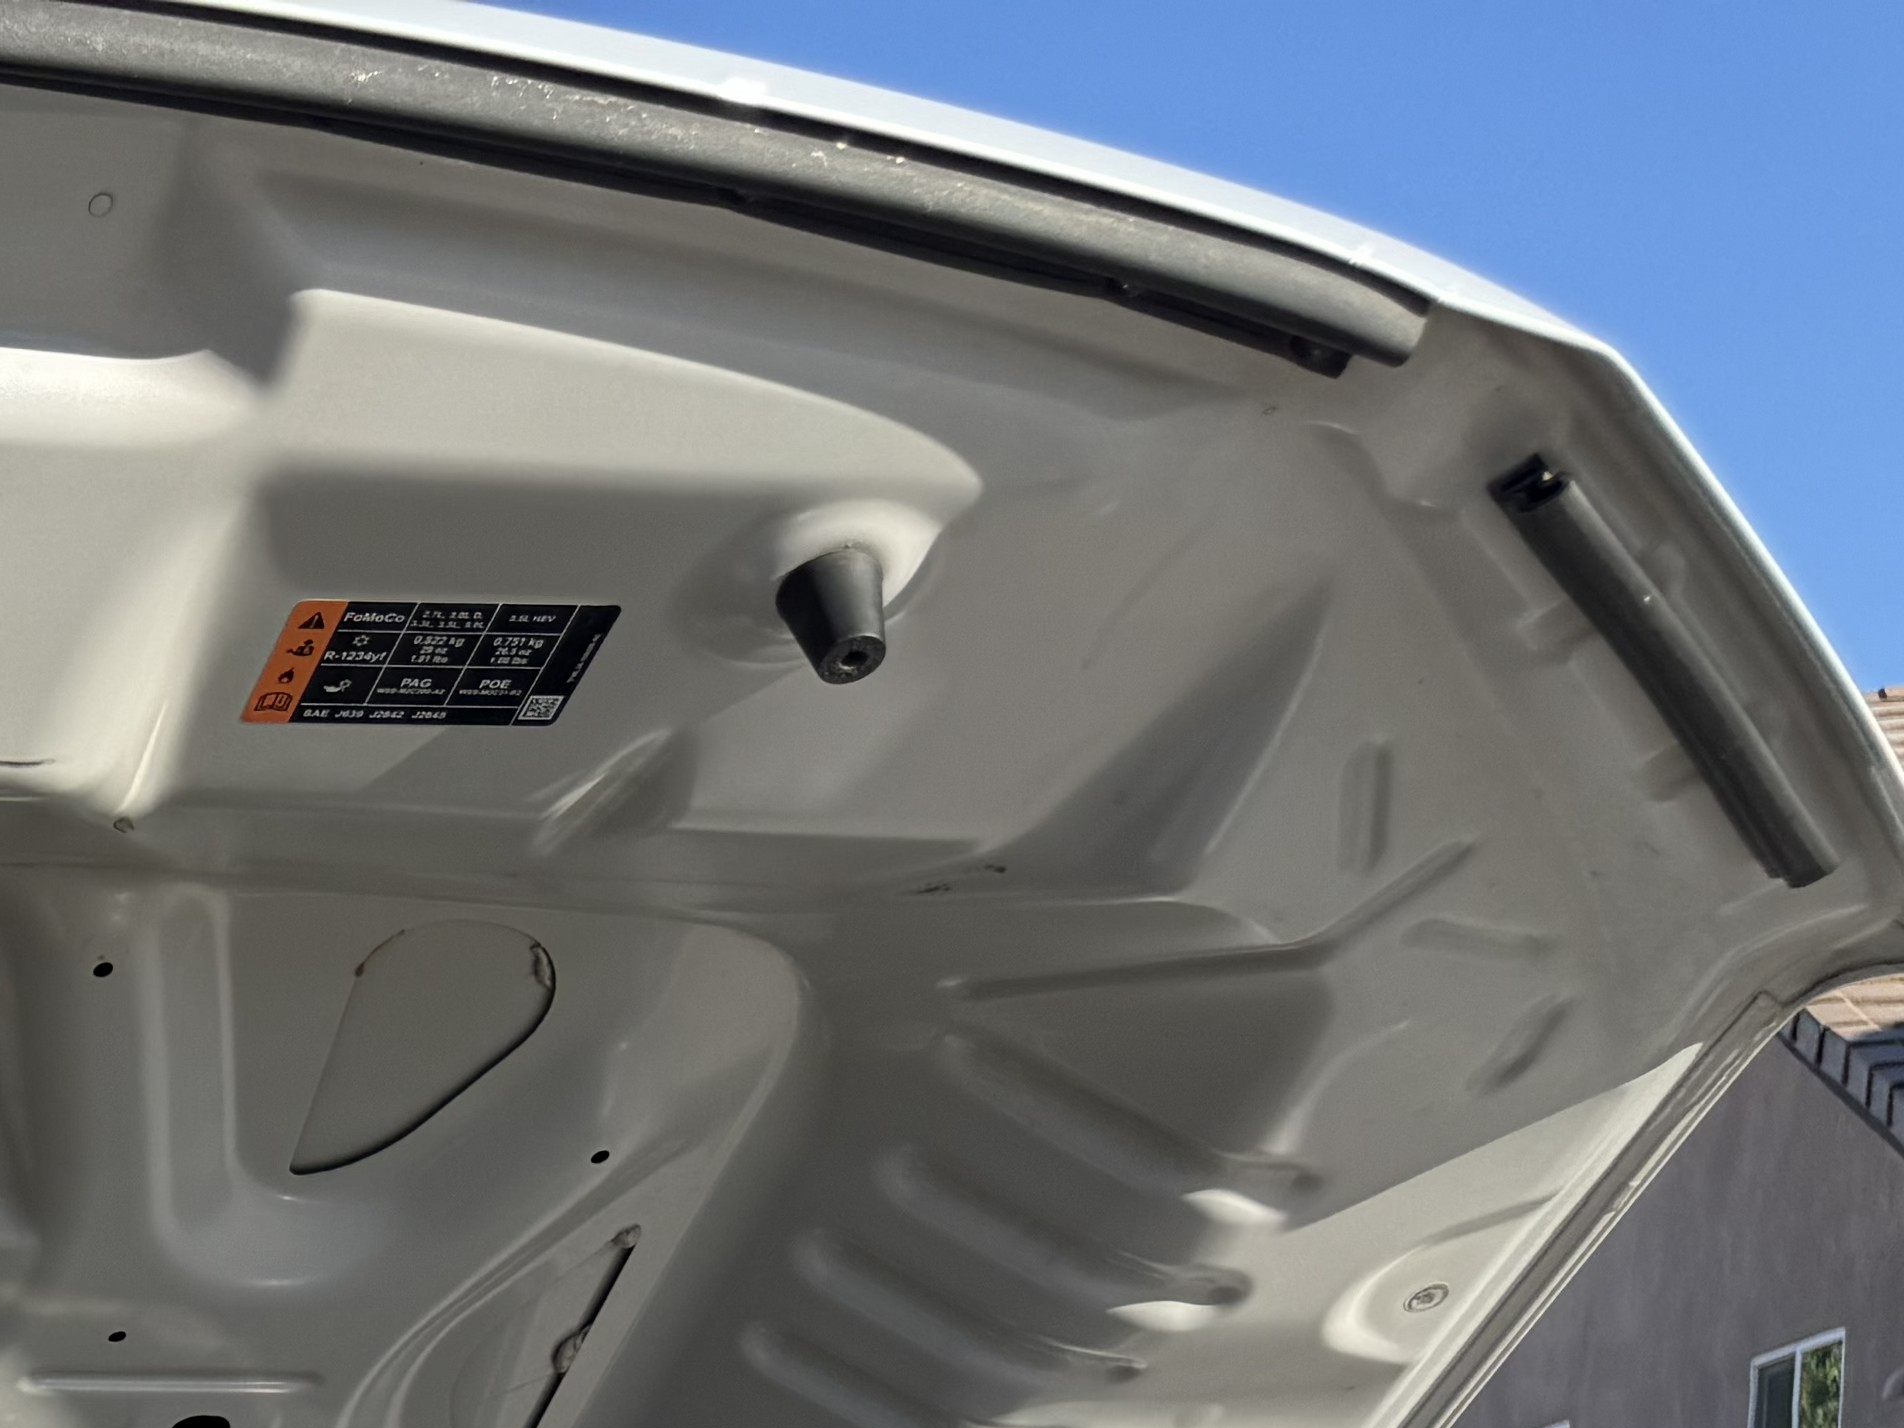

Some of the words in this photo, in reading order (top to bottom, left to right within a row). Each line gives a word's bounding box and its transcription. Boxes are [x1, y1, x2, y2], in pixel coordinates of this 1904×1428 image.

[342, 612, 407, 623] FoMoCo
[446, 636, 466, 647] kg
[525, 637, 545, 649] kg
[322, 650, 387, 662] R-1234yf
[398, 678, 434, 687] PAG
[478, 679, 512, 689] POE
